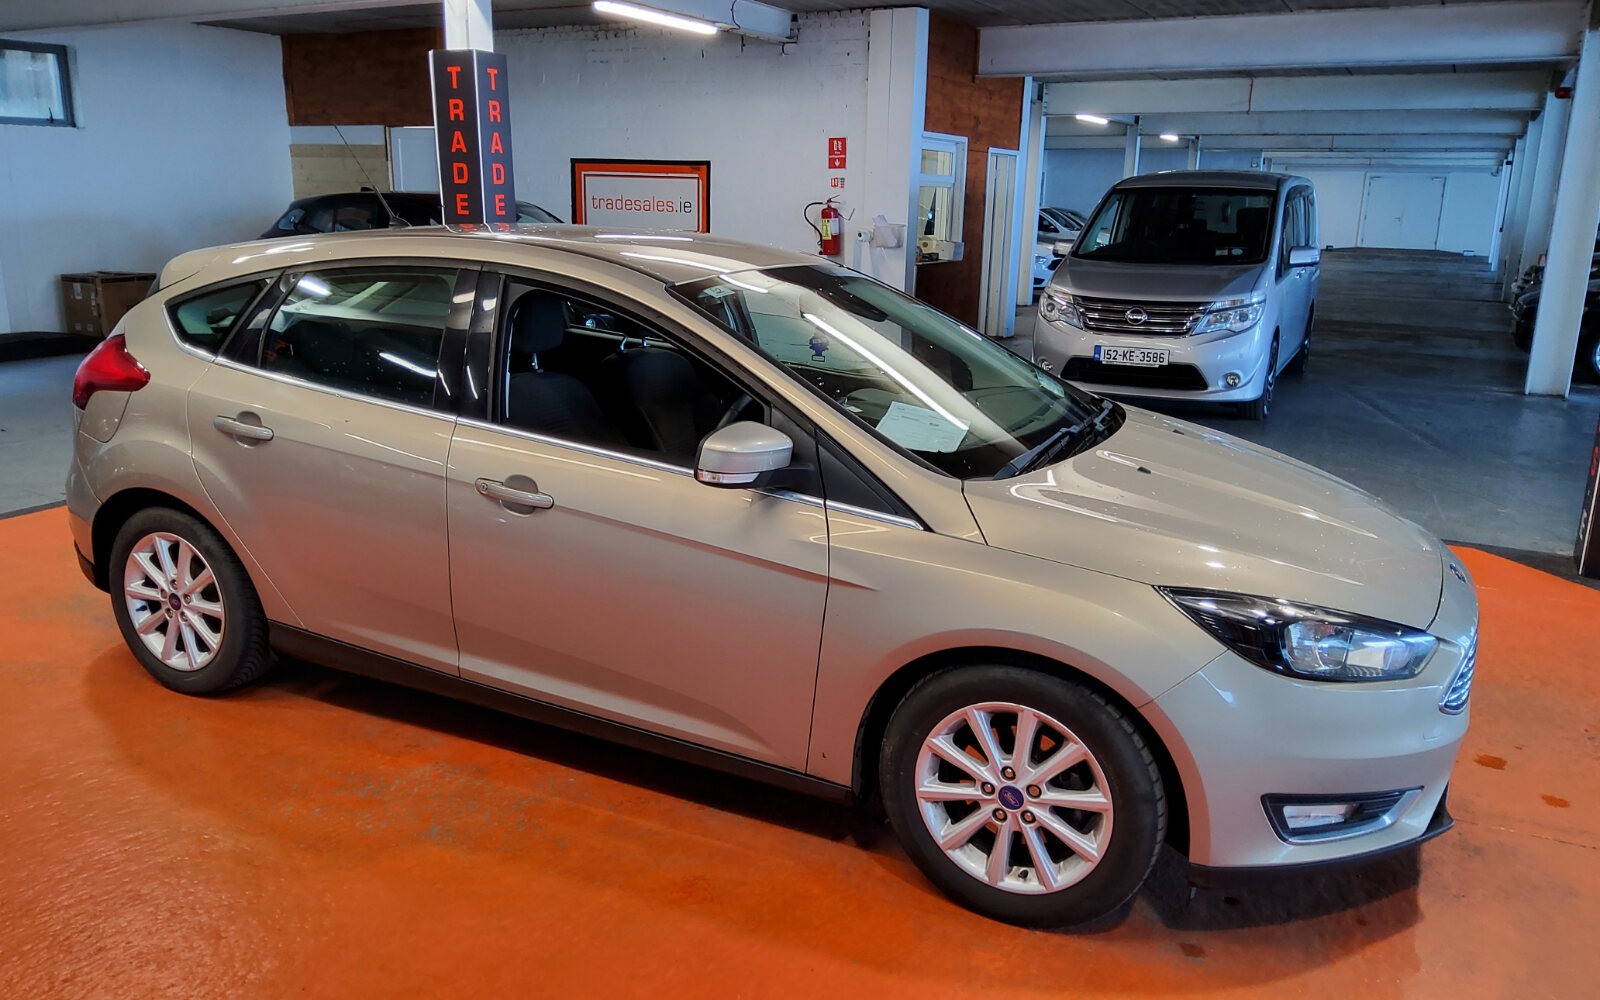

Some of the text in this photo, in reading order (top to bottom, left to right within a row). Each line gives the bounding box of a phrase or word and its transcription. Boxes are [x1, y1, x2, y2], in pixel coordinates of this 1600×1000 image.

[446, 66, 470, 215] TRADE
[486, 68, 506, 216] TRADE
[591, 194, 692, 213] tradesales.ie
[1103, 349, 1165, 363] 152-KE-3586
